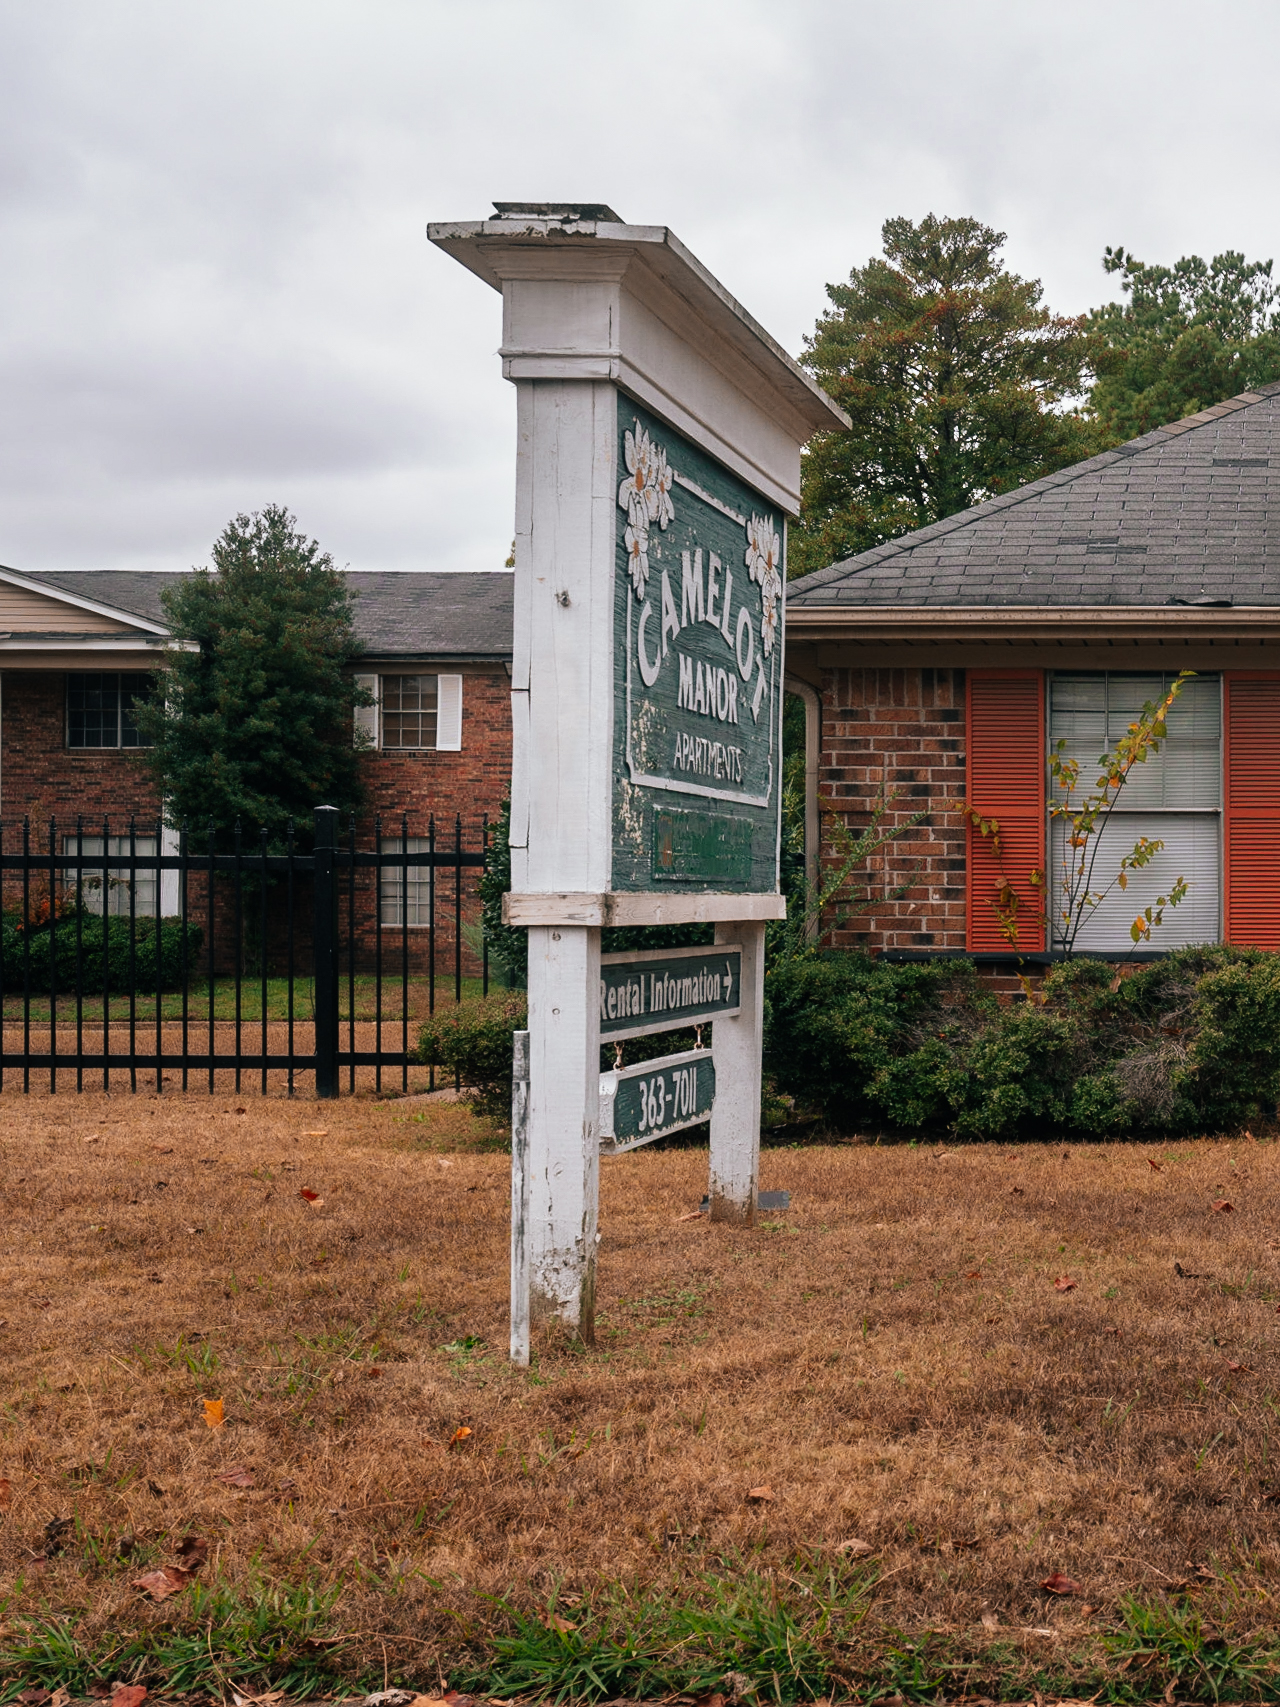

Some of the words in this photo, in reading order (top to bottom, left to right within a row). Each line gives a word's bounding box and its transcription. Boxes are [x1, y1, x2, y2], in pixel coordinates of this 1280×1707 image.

[637, 548, 767, 725] CAMELOT
[677, 653, 738, 724] MANOR
[673, 731, 742, 783] APARTMENTS
[650, 966, 721, 1012] Information
[638, 1067, 697, 1131] 363-7011
